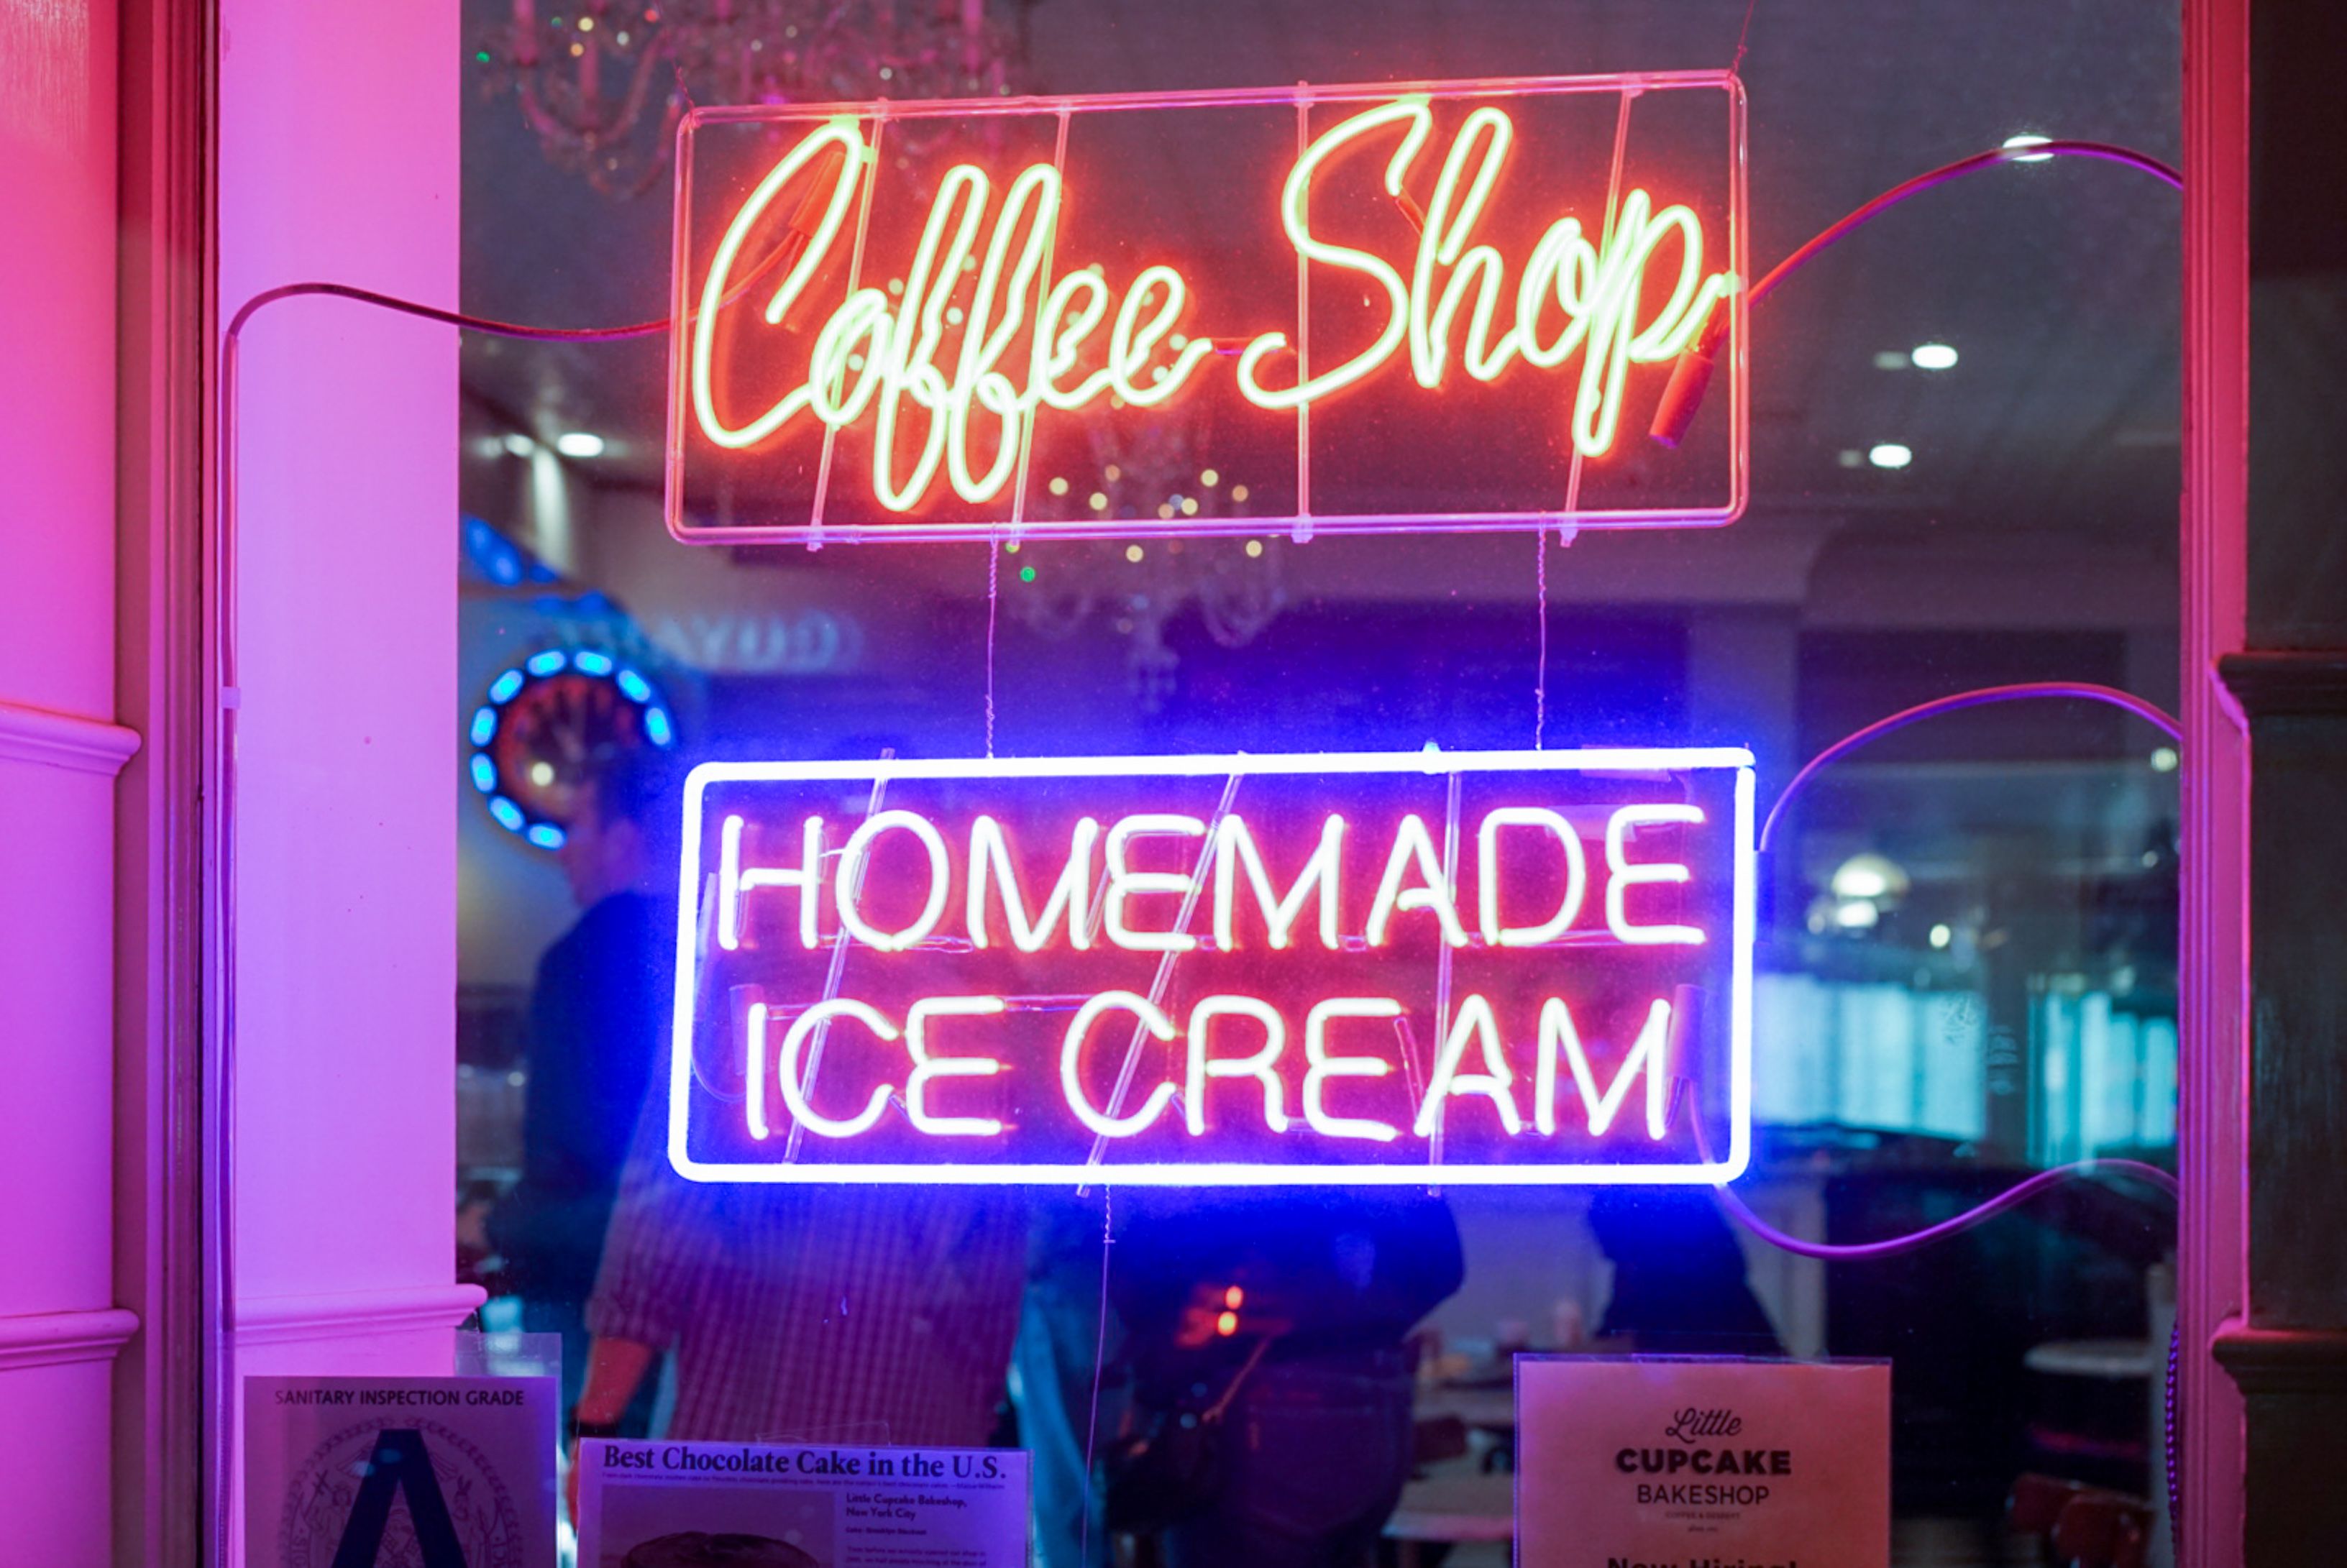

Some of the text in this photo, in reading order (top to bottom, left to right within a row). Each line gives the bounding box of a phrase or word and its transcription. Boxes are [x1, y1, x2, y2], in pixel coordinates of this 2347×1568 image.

[692, 99, 1742, 512] Coffee Shop
[715, 802, 1708, 953] HOMEMADE
[744, 989, 1673, 1142] ICE CREAM
[275, 1390, 525, 1406] SANITARY INSPECTION GRADE
[1665, 1406, 1743, 1445] Little
[603, 1444, 1007, 1480] Best Chocolate Cake in the U.S.
[1615, 1448, 1792, 1477] CUPCAKE
[846, 1493, 871, 1503] Little
[874, 1494, 916, 1507] Cupcake
[1637, 1484, 1770, 1505] BAKESHOP
[846, 1507, 916, 1521] New York City
